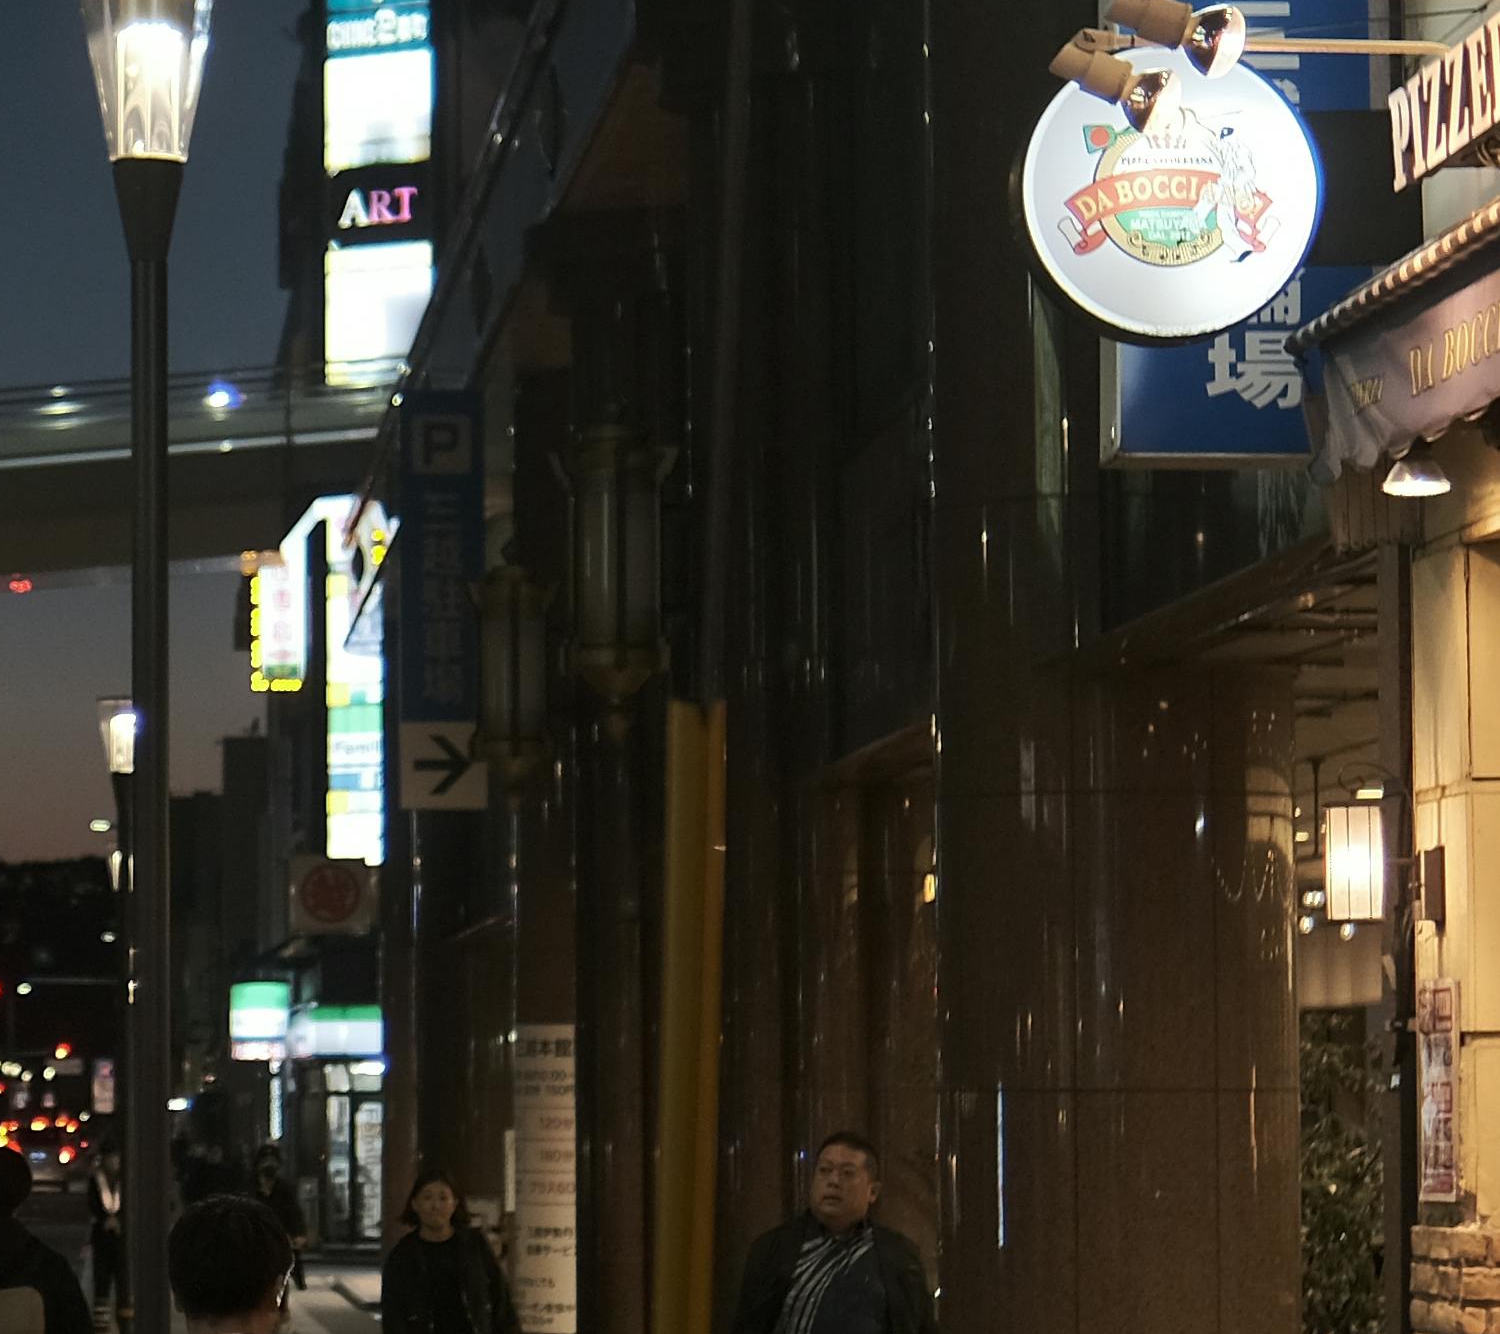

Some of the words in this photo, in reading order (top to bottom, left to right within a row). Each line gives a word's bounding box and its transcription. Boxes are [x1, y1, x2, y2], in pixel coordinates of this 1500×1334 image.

[338, 186, 418, 229] ART
[1075, 190, 1114, 219] DA
[422, 422, 460, 466] P
